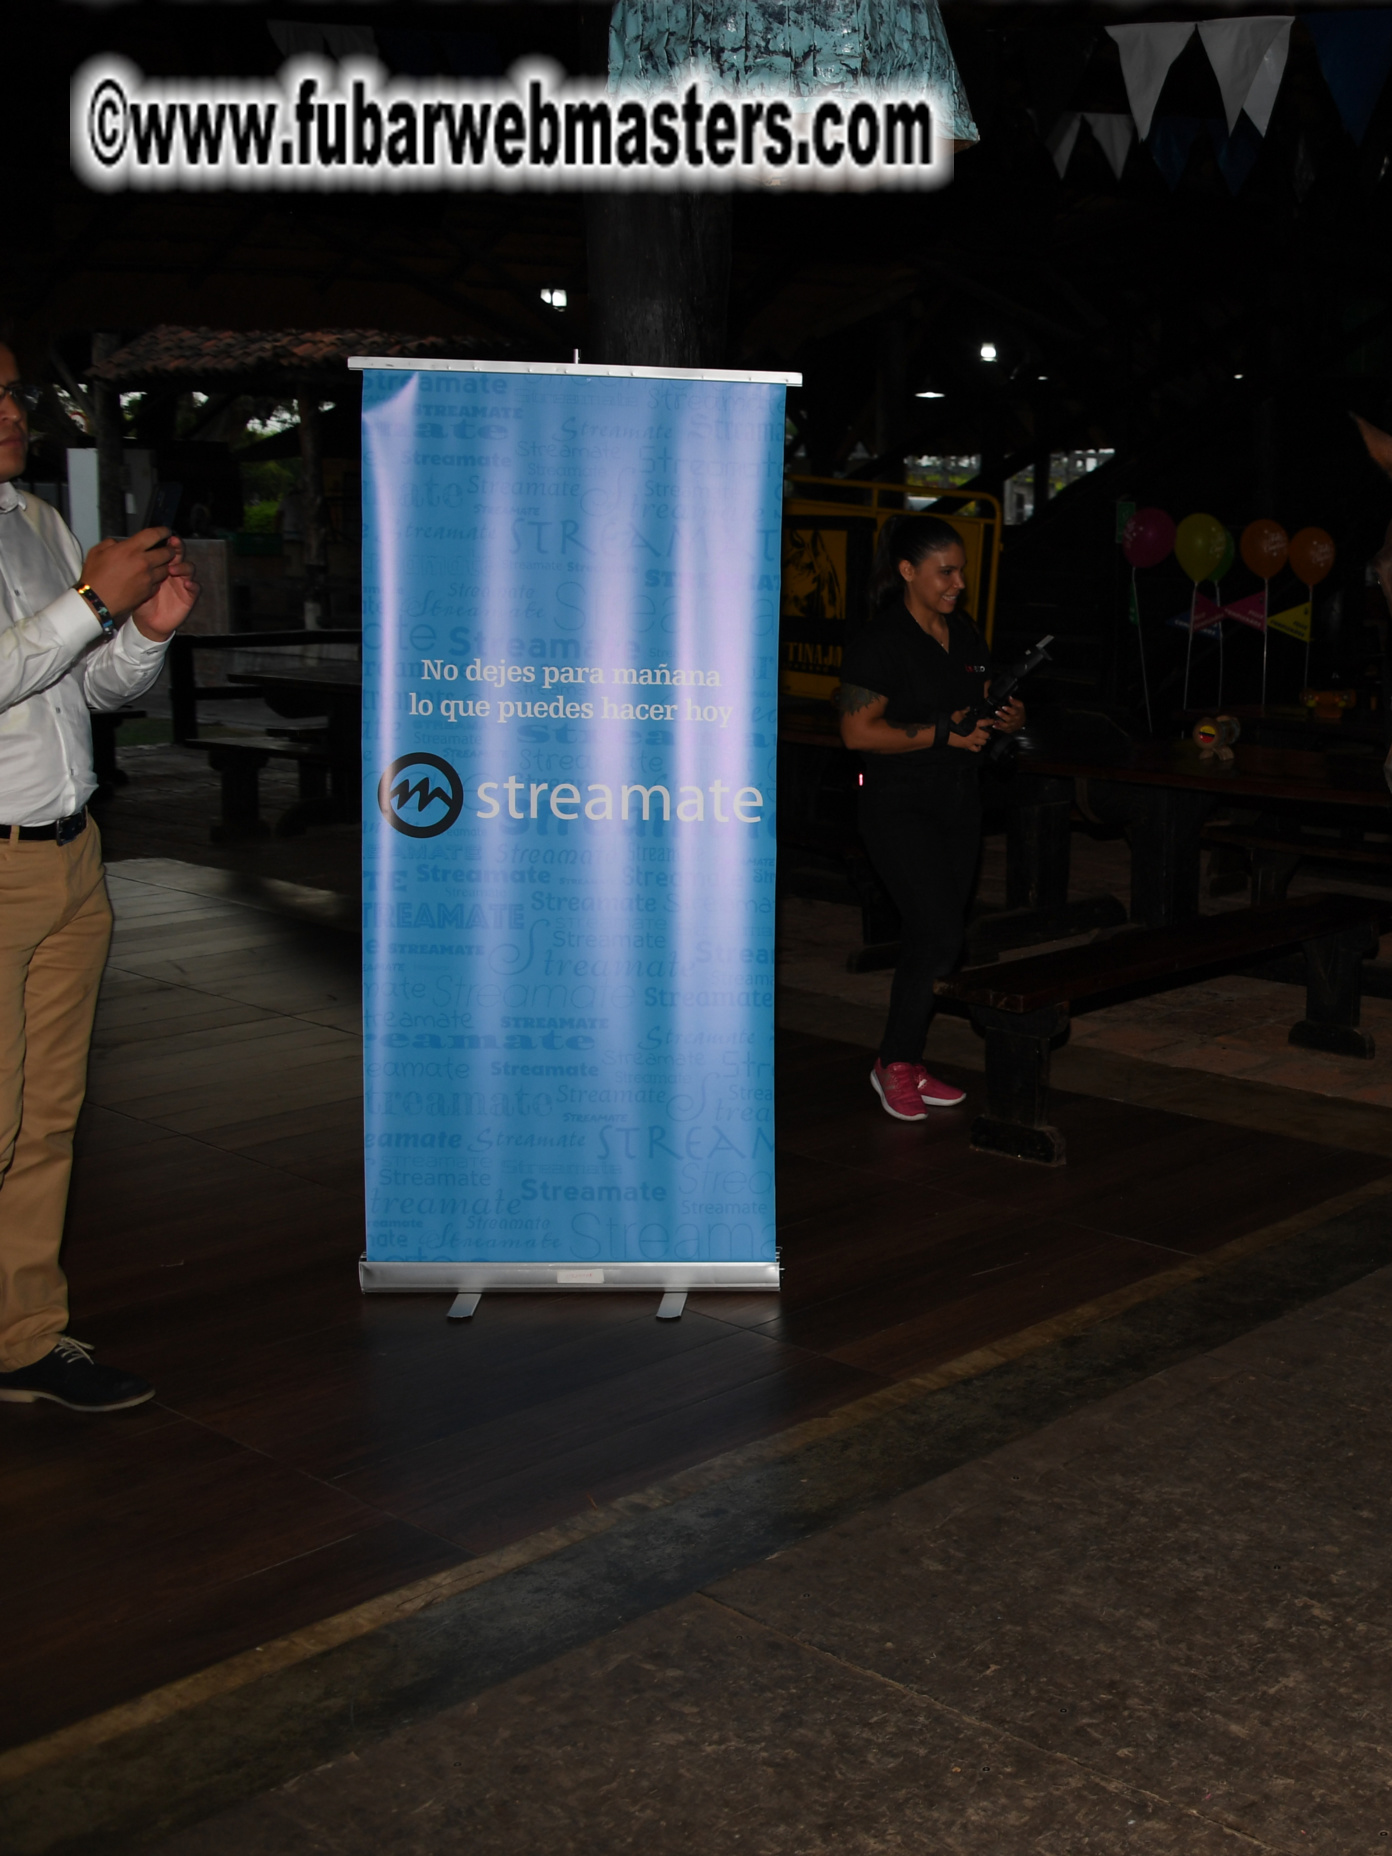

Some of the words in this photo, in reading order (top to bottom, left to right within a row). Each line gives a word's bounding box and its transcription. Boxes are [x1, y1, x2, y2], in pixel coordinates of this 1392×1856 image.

[467, 475, 581, 497] Streamate
[421, 659, 458, 681] No
[466, 659, 535, 688] dejes
[542, 663, 604, 688] para
[612, 664, 721, 688] mañana
[409, 693, 434, 716] lo
[440, 696, 490, 722] que
[497, 695, 594, 723] puedes
[601, 696, 678, 722] hacer
[685, 698, 734, 728] hoy
[476, 775, 764, 823] streamate
[416, 864, 550, 884] Streamate
[531, 890, 656, 912] Streamate
[387, 942, 485, 956] STREAMATE
[552, 929, 667, 949] Streamate
[432, 975, 636, 1009] Streamate
[500, 1015, 609, 1030] STREAMATE
[601, 1049, 706, 1067] Streamate
[491, 1060, 599, 1078] Streamate
[615, 1070, 692, 1085] Streamate
[556, 1084, 667, 1104] Streamate
[562, 1111, 629, 1123] STREAMATE
[467, 1126, 586, 1153] Streamate
[379, 1168, 492, 1187] Streamate
[521, 1178, 667, 1202] Streamate
[681, 1200, 768, 1215] Streamate
